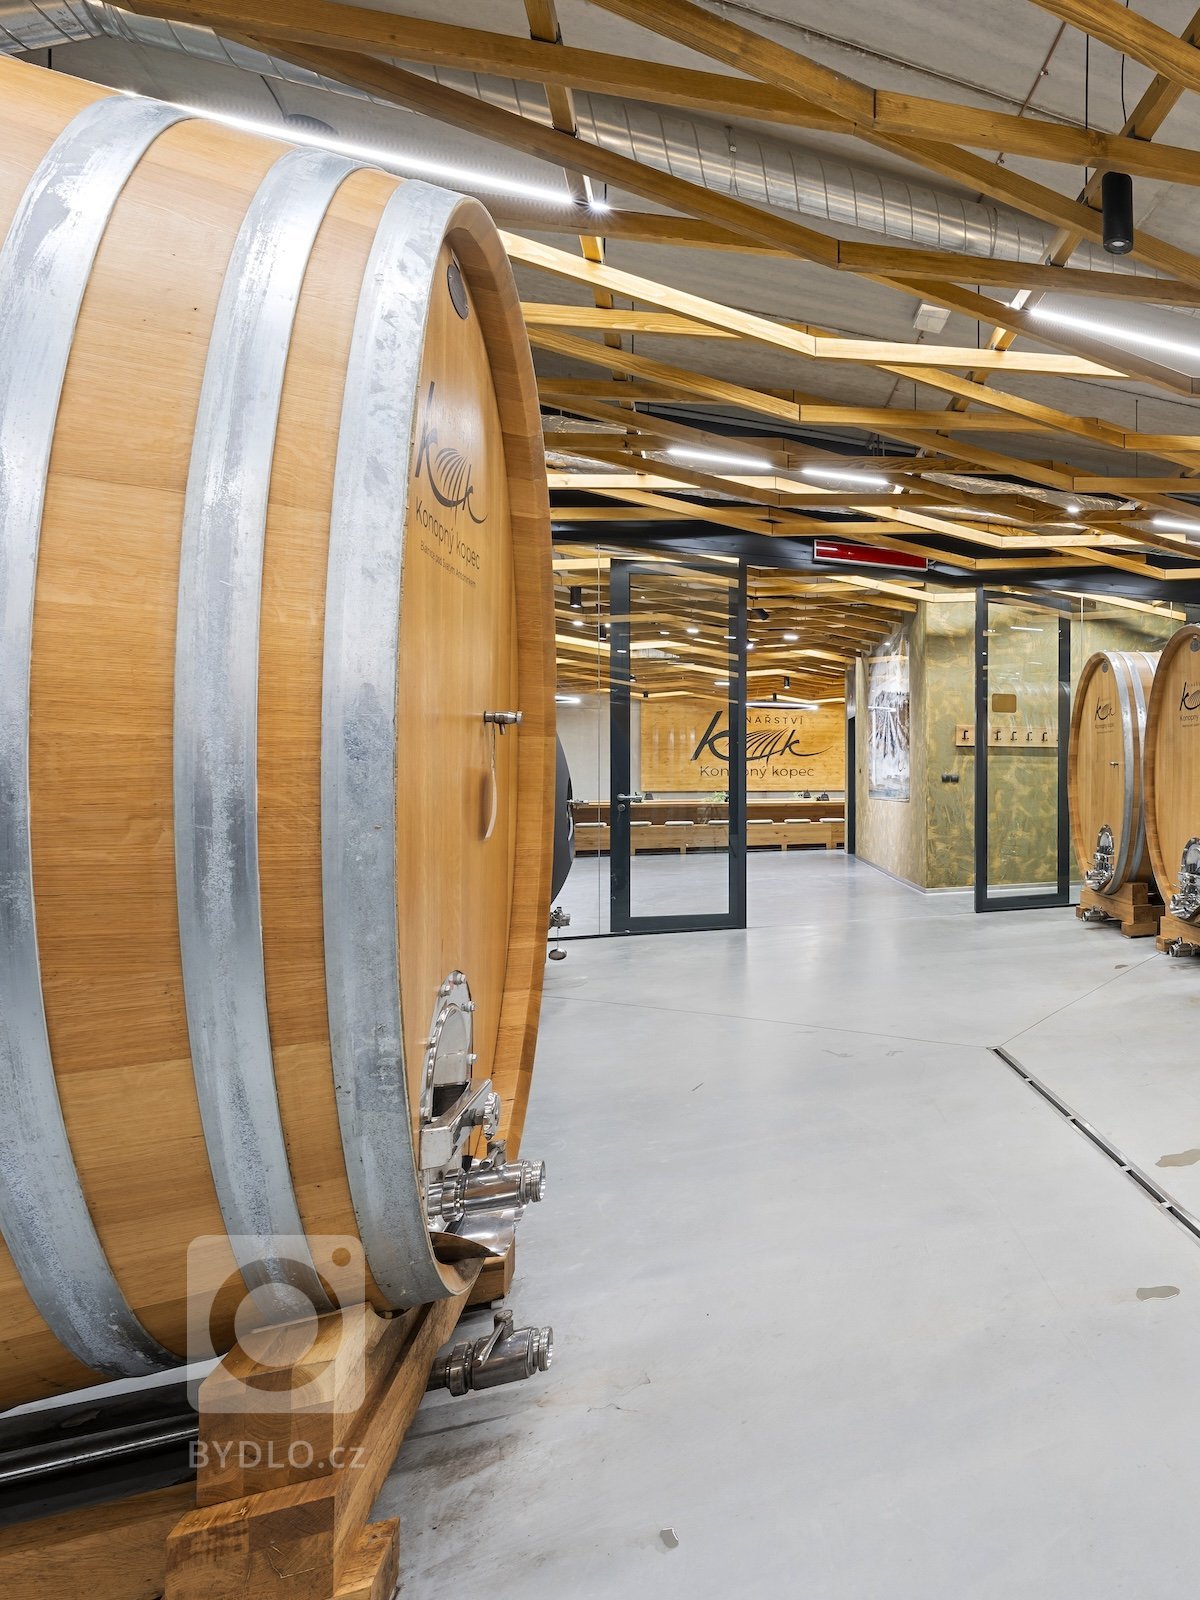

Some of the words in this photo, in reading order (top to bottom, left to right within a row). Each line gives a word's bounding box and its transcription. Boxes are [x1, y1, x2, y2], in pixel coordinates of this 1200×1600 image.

[416, 496, 455, 555] Konopný
[456, 531, 480, 570] kopec
[746, 714, 804, 725] NAŘSTVÍ
[700, 764, 768, 779] Konný
[771, 765, 815, 779] kopec
